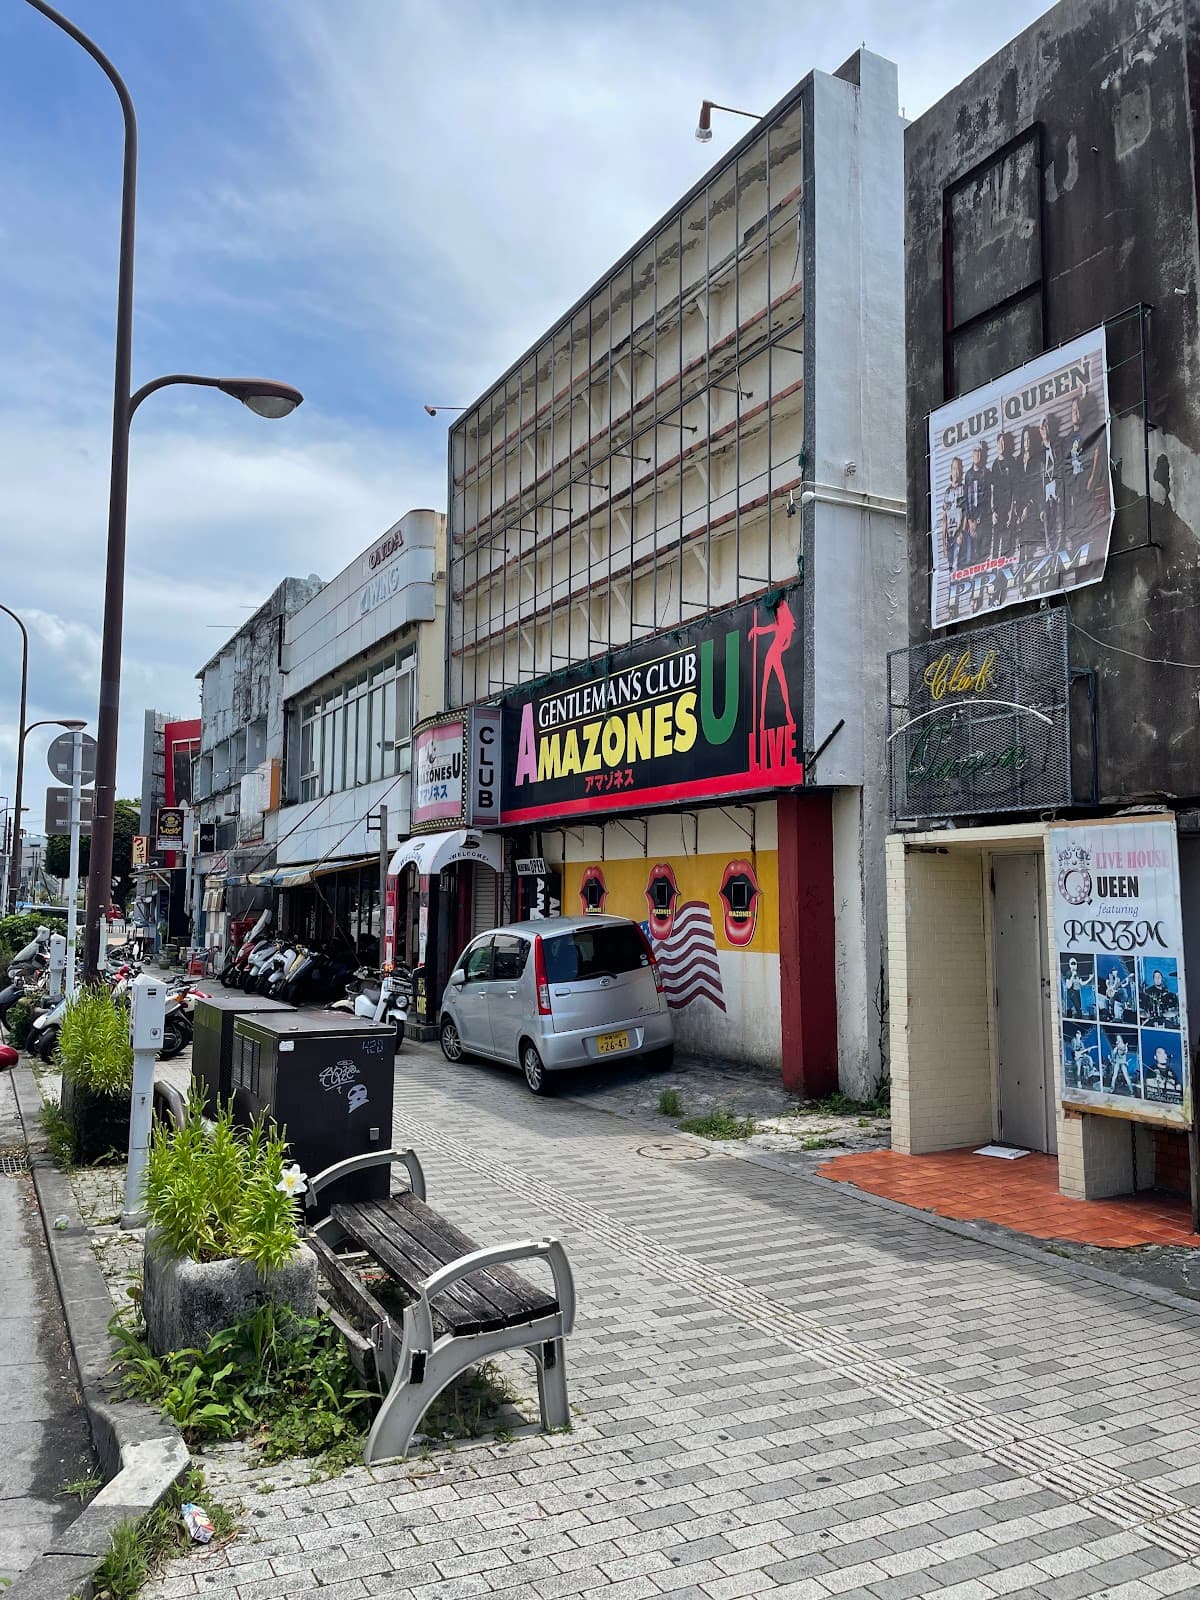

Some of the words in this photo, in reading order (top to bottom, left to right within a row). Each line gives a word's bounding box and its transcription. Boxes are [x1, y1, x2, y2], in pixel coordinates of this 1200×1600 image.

[942, 406, 999, 448] CLUB
[1004, 360, 1092, 420] QUEEN
[949, 543, 1092, 606] PRYZM
[538, 670, 642, 728] GENTLEMAN'S
[645, 652, 697, 695] CLUB
[924, 650, 996, 700] Club
[515, 691, 698, 787] AMAZONES
[701, 630, 740, 745] U
[478, 726, 495, 808] CLUB
[749, 722, 798, 773] LIVE
[584, 768, 635, 793] アマゾネス
[1095, 851, 1123, 870] LIVE
[1126, 849, 1170, 870] HOUSE
[1096, 902, 1140, 918] featuring
